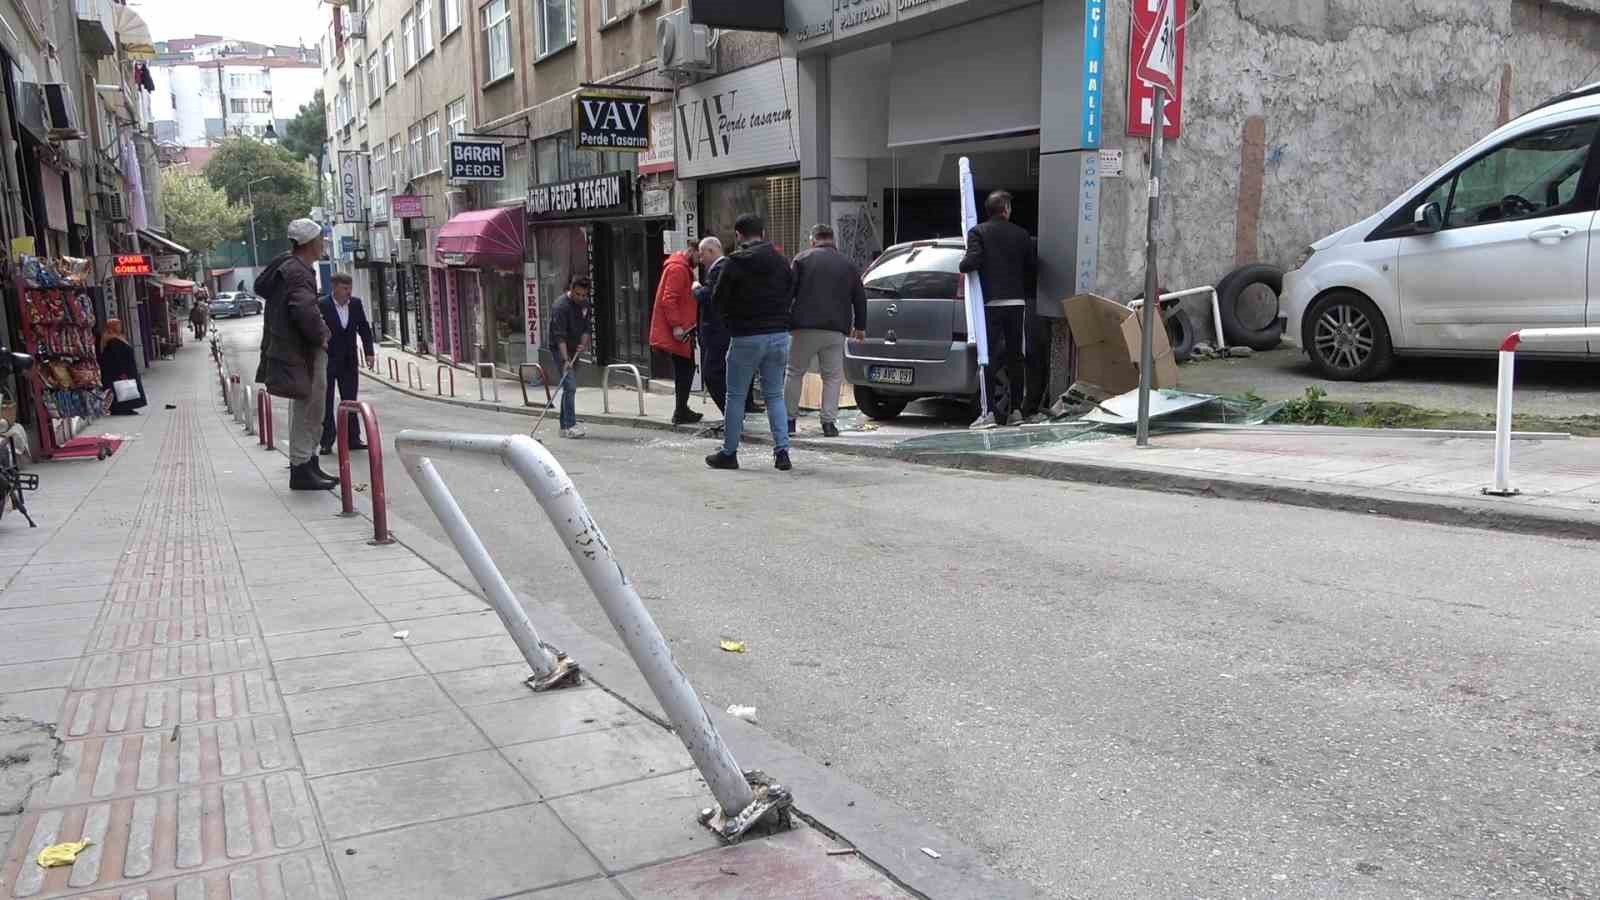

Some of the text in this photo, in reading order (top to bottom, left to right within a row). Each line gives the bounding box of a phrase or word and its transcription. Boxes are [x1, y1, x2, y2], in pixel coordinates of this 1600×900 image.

[582, 100, 645, 130] VAV
[677, 89, 738, 161] VAV
[718, 112, 746, 132] Perde
[454, 145, 500, 162] BARAN
[581, 132, 609, 145] Perde
[456, 164, 501, 176] PERDE
[551, 182, 578, 212] PERDE
[578, 175, 621, 209] TASARIM
[526, 283, 538, 345] TERZİ
